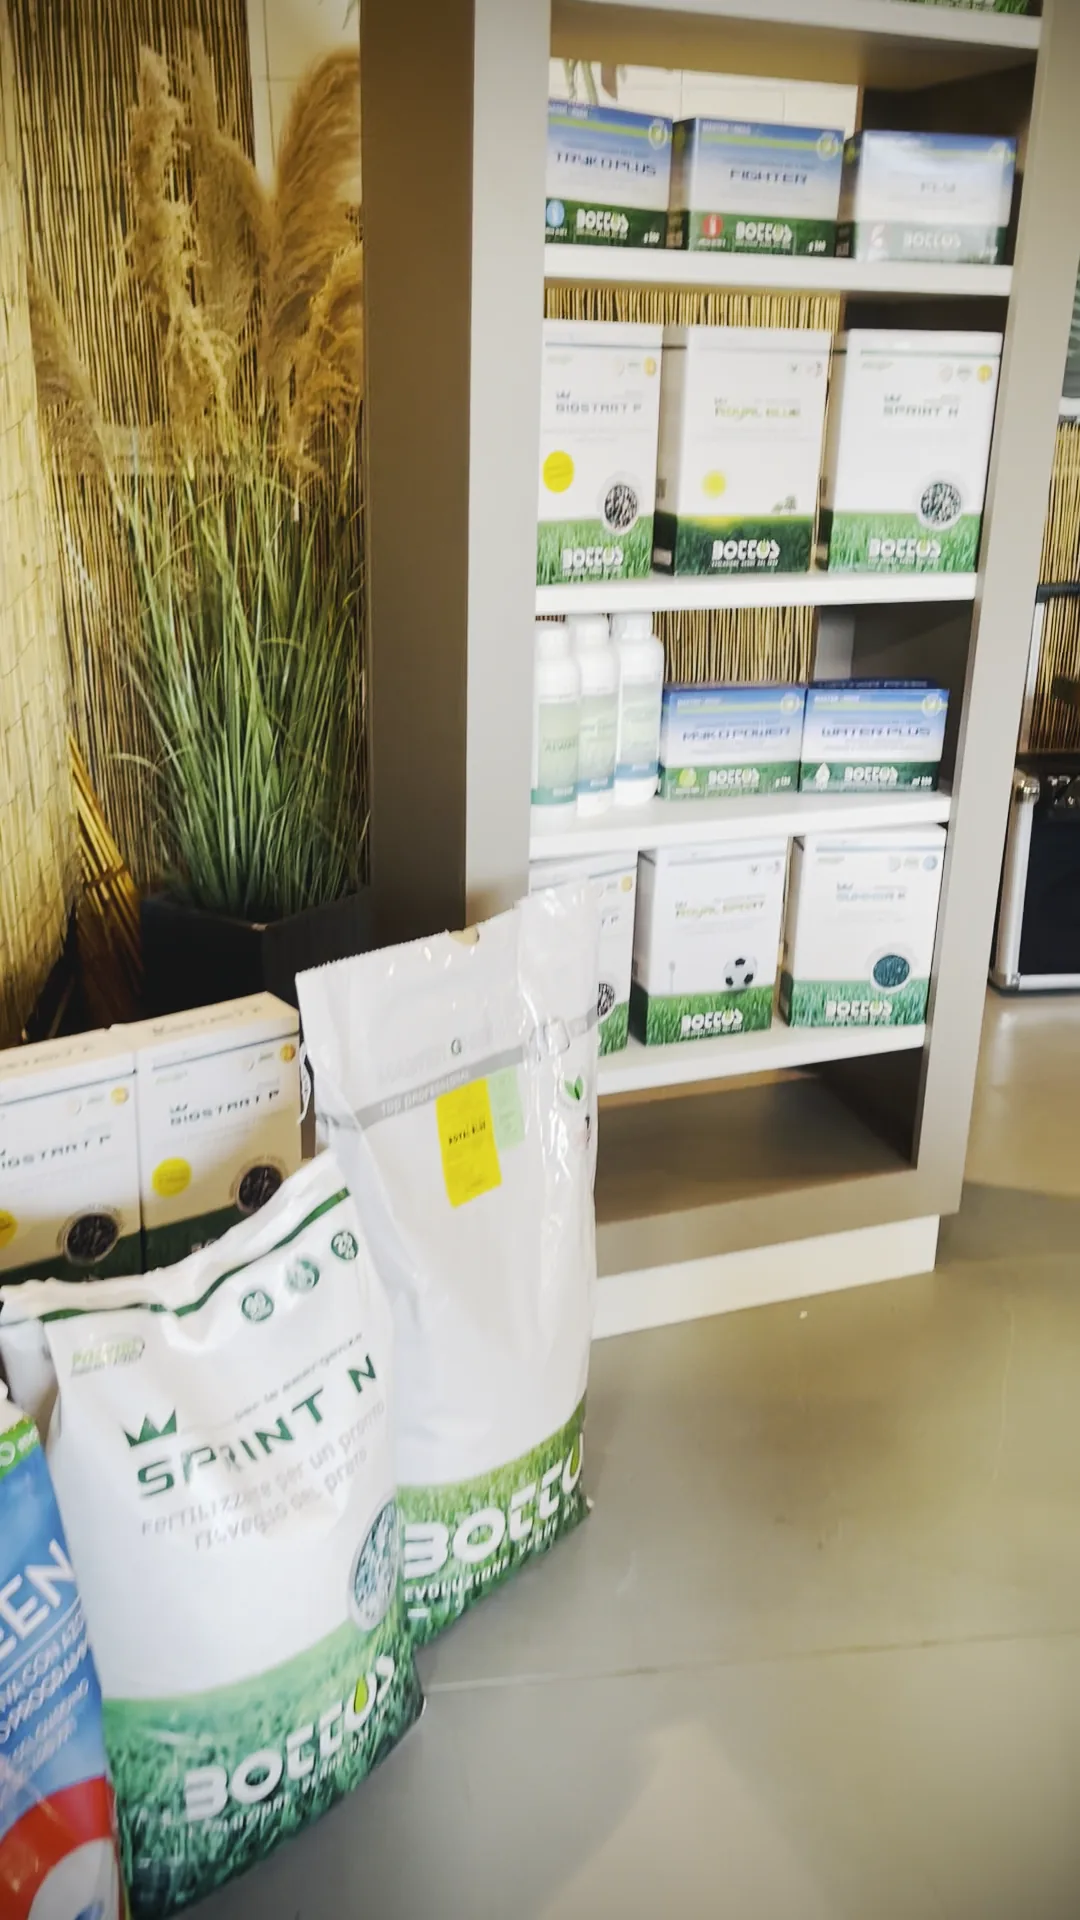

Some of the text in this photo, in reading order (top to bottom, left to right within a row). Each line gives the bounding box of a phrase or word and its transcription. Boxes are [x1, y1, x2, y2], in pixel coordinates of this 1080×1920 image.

[729, 169, 808, 185] FIGHTER
[711, 538, 781, 562] BOTTOS
[136, 1353, 377, 1498] SPRINT N
